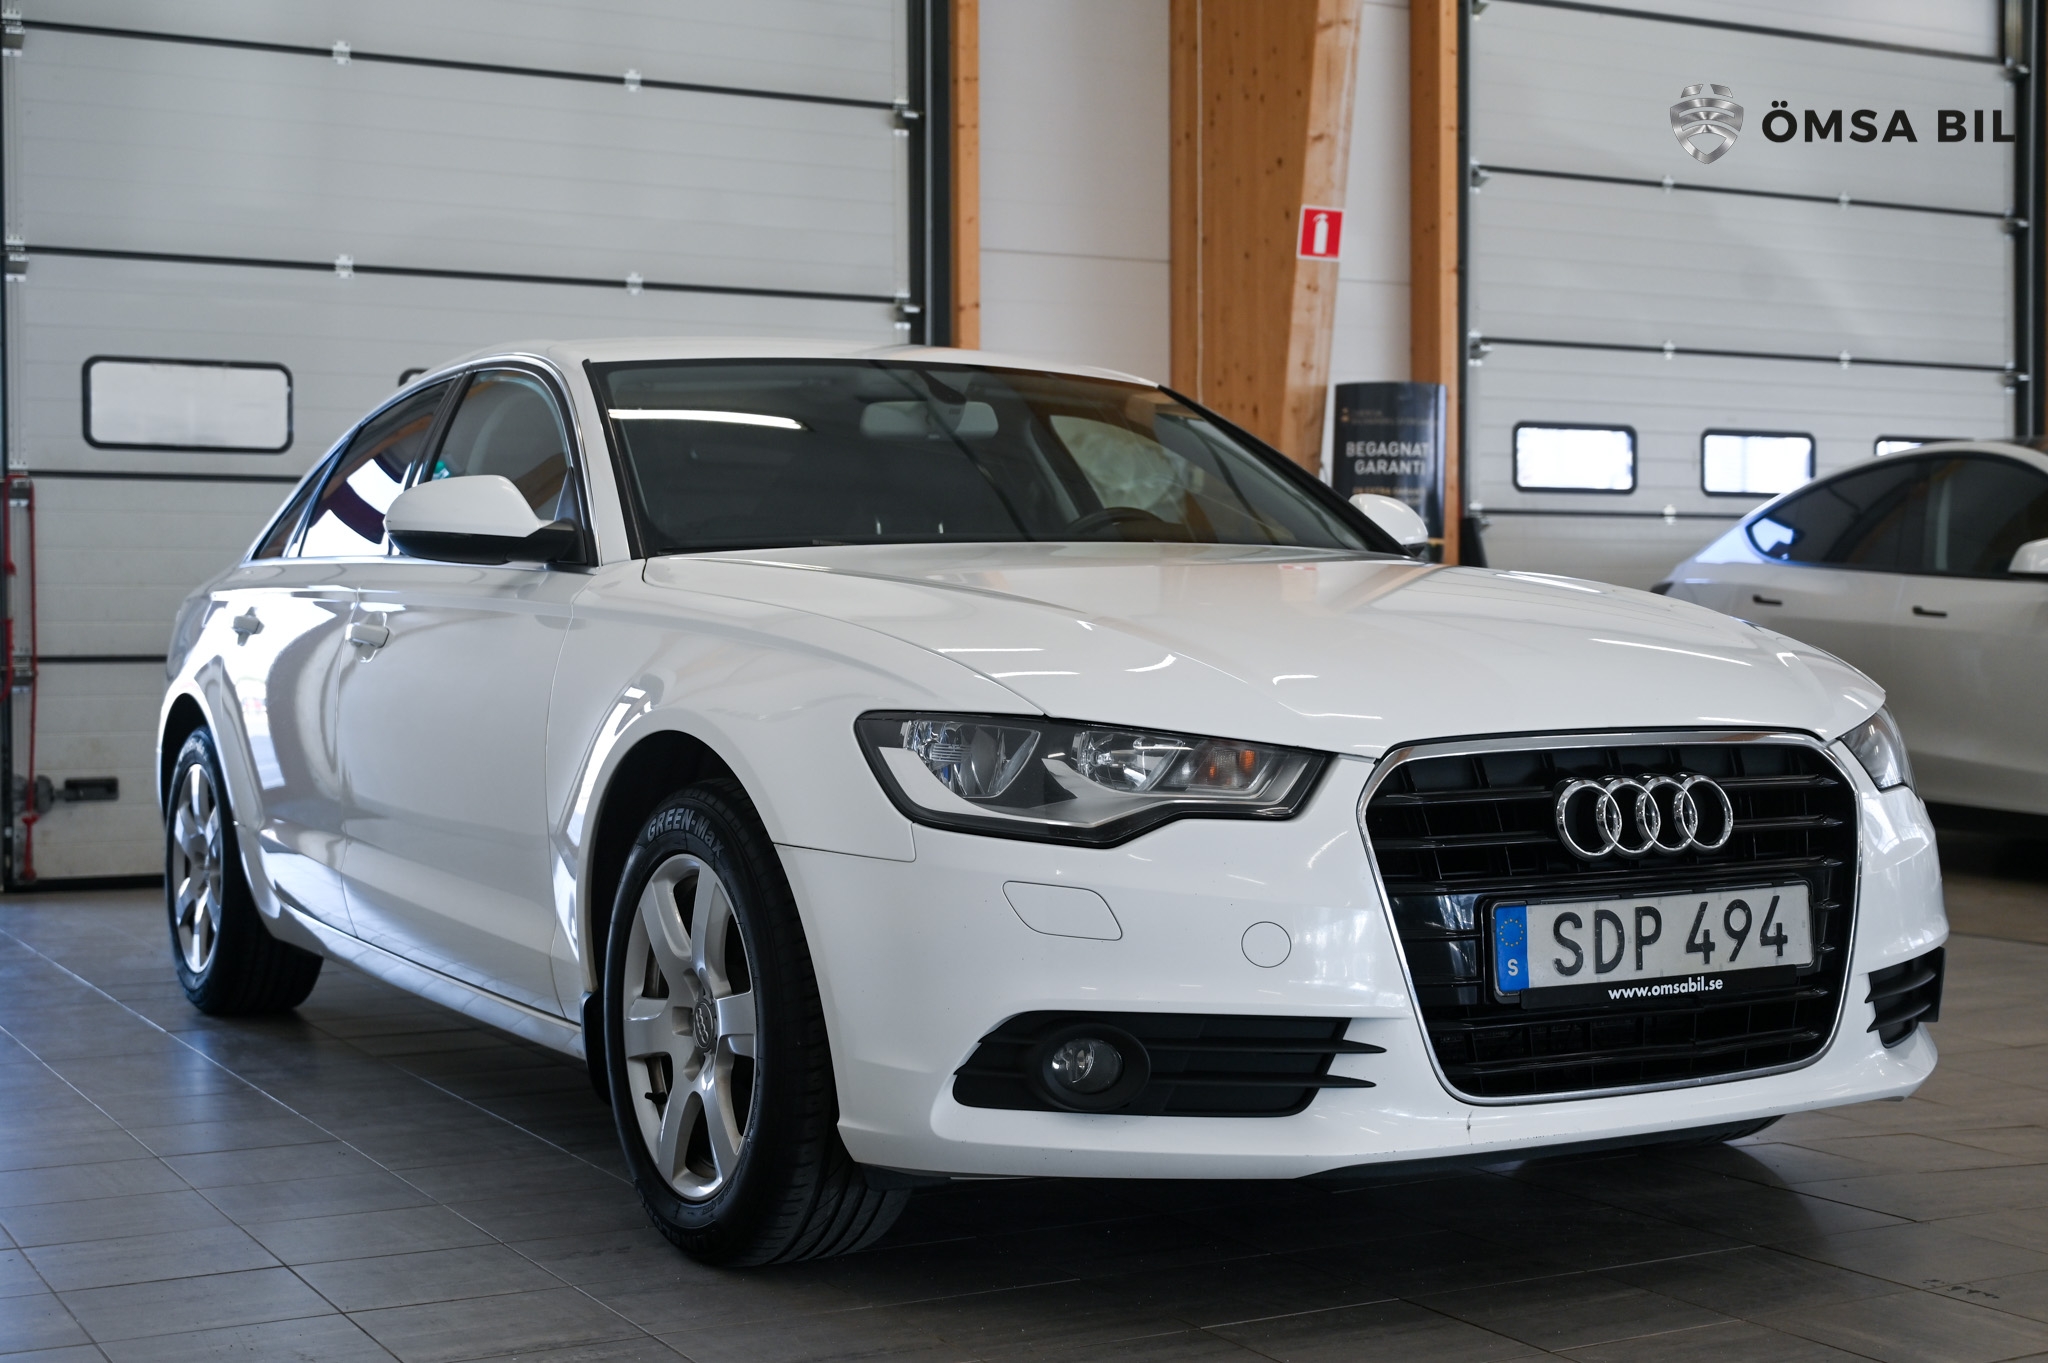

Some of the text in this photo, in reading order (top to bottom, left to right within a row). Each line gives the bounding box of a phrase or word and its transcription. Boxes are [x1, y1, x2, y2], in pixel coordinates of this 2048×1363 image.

[1354, 459, 1426, 476] GARANTI
[647, 807, 725, 858] GREEN-Max
[1552, 895, 1788, 977] SDP 494
[1507, 958, 1519, 977] S
[1608, 976, 1724, 1000] www.omsabil.se
